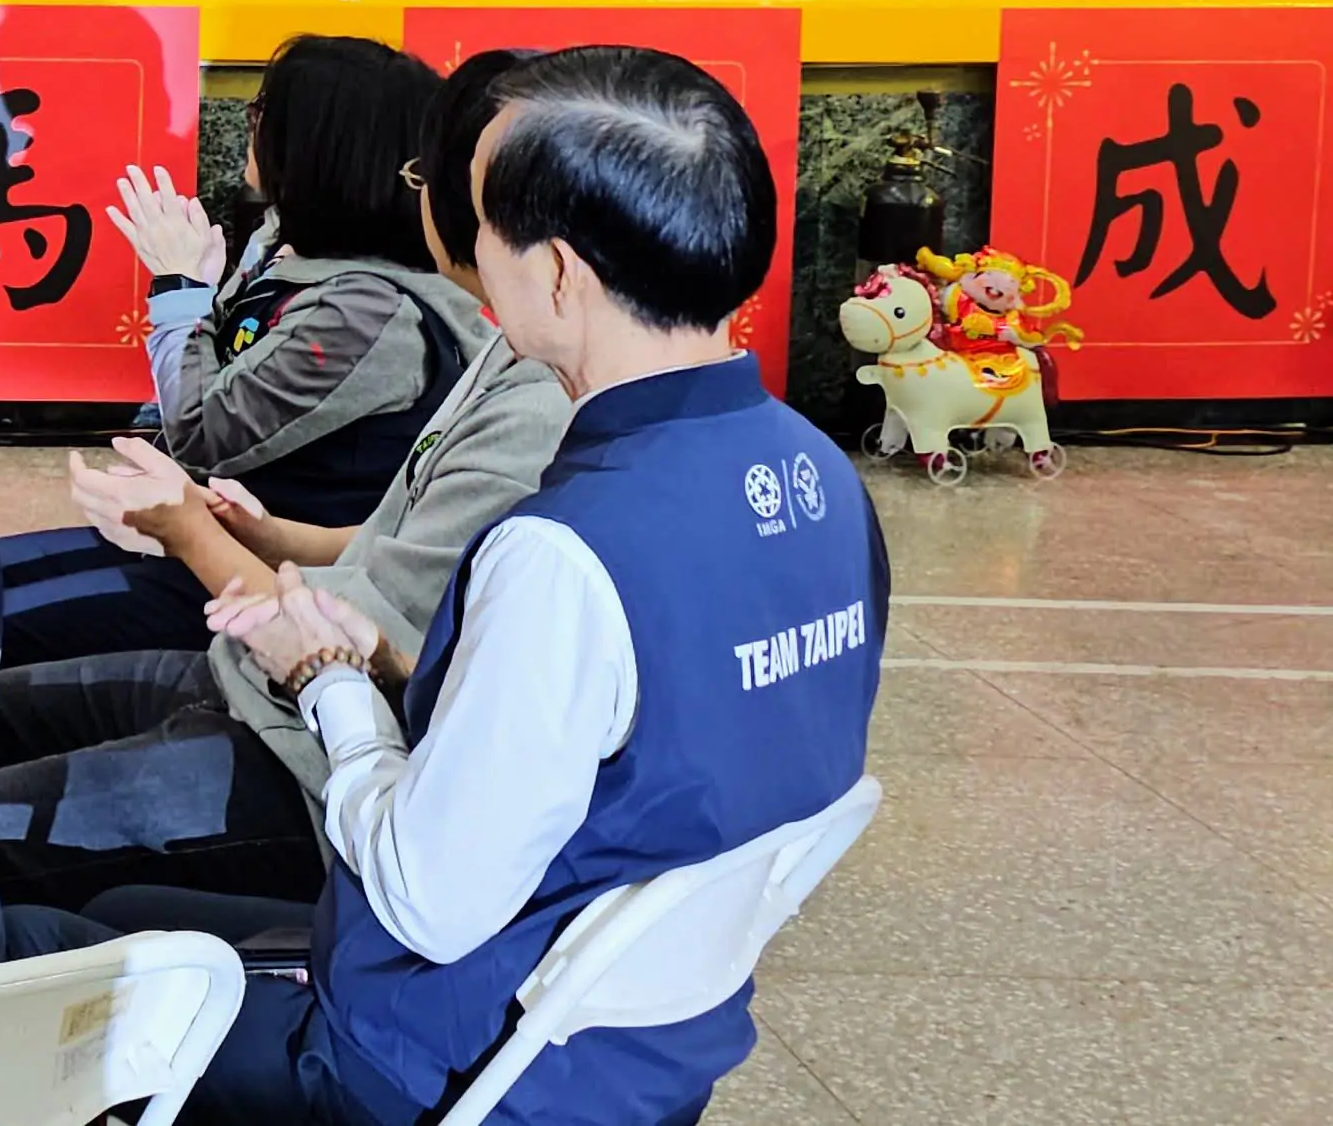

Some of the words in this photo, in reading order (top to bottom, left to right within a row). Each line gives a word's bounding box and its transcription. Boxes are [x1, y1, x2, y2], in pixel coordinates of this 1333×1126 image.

[1073, 82, 1277, 320] 成
[756, 519, 786, 538] IMGA
[734, 627, 799, 691] TEAM
[800, 601, 865, 668] TAIPEI
